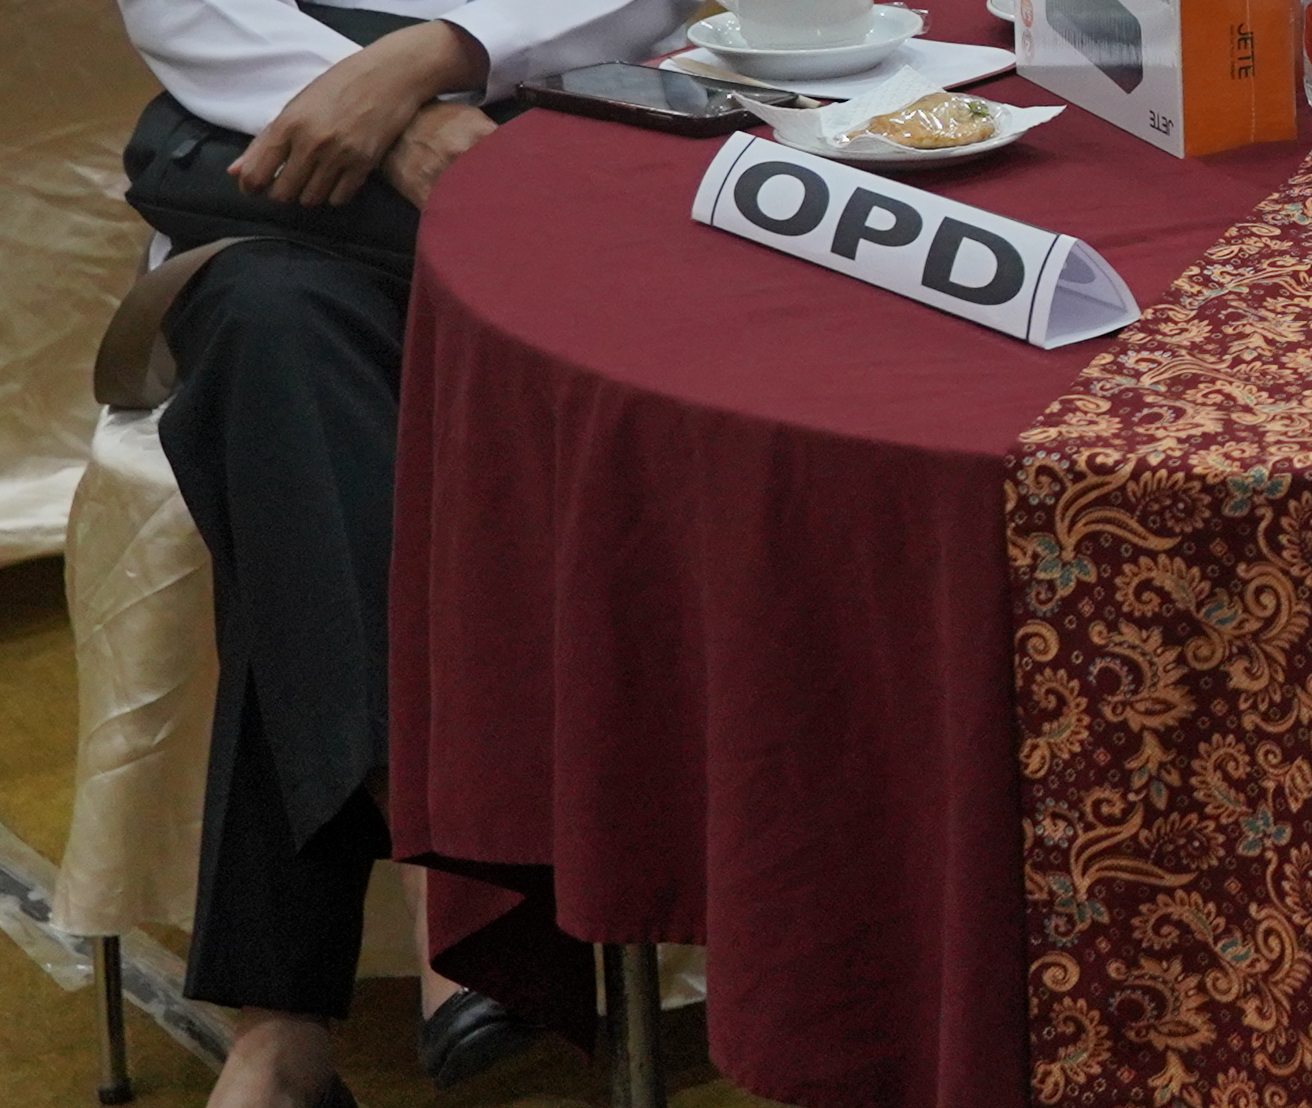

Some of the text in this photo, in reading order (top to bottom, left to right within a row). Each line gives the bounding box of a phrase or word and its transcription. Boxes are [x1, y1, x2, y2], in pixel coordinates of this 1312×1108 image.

[1237, 23, 1255, 80] JETE
[1149, 109, 1174, 136] JETE
[733, 160, 1026, 306] OPD
